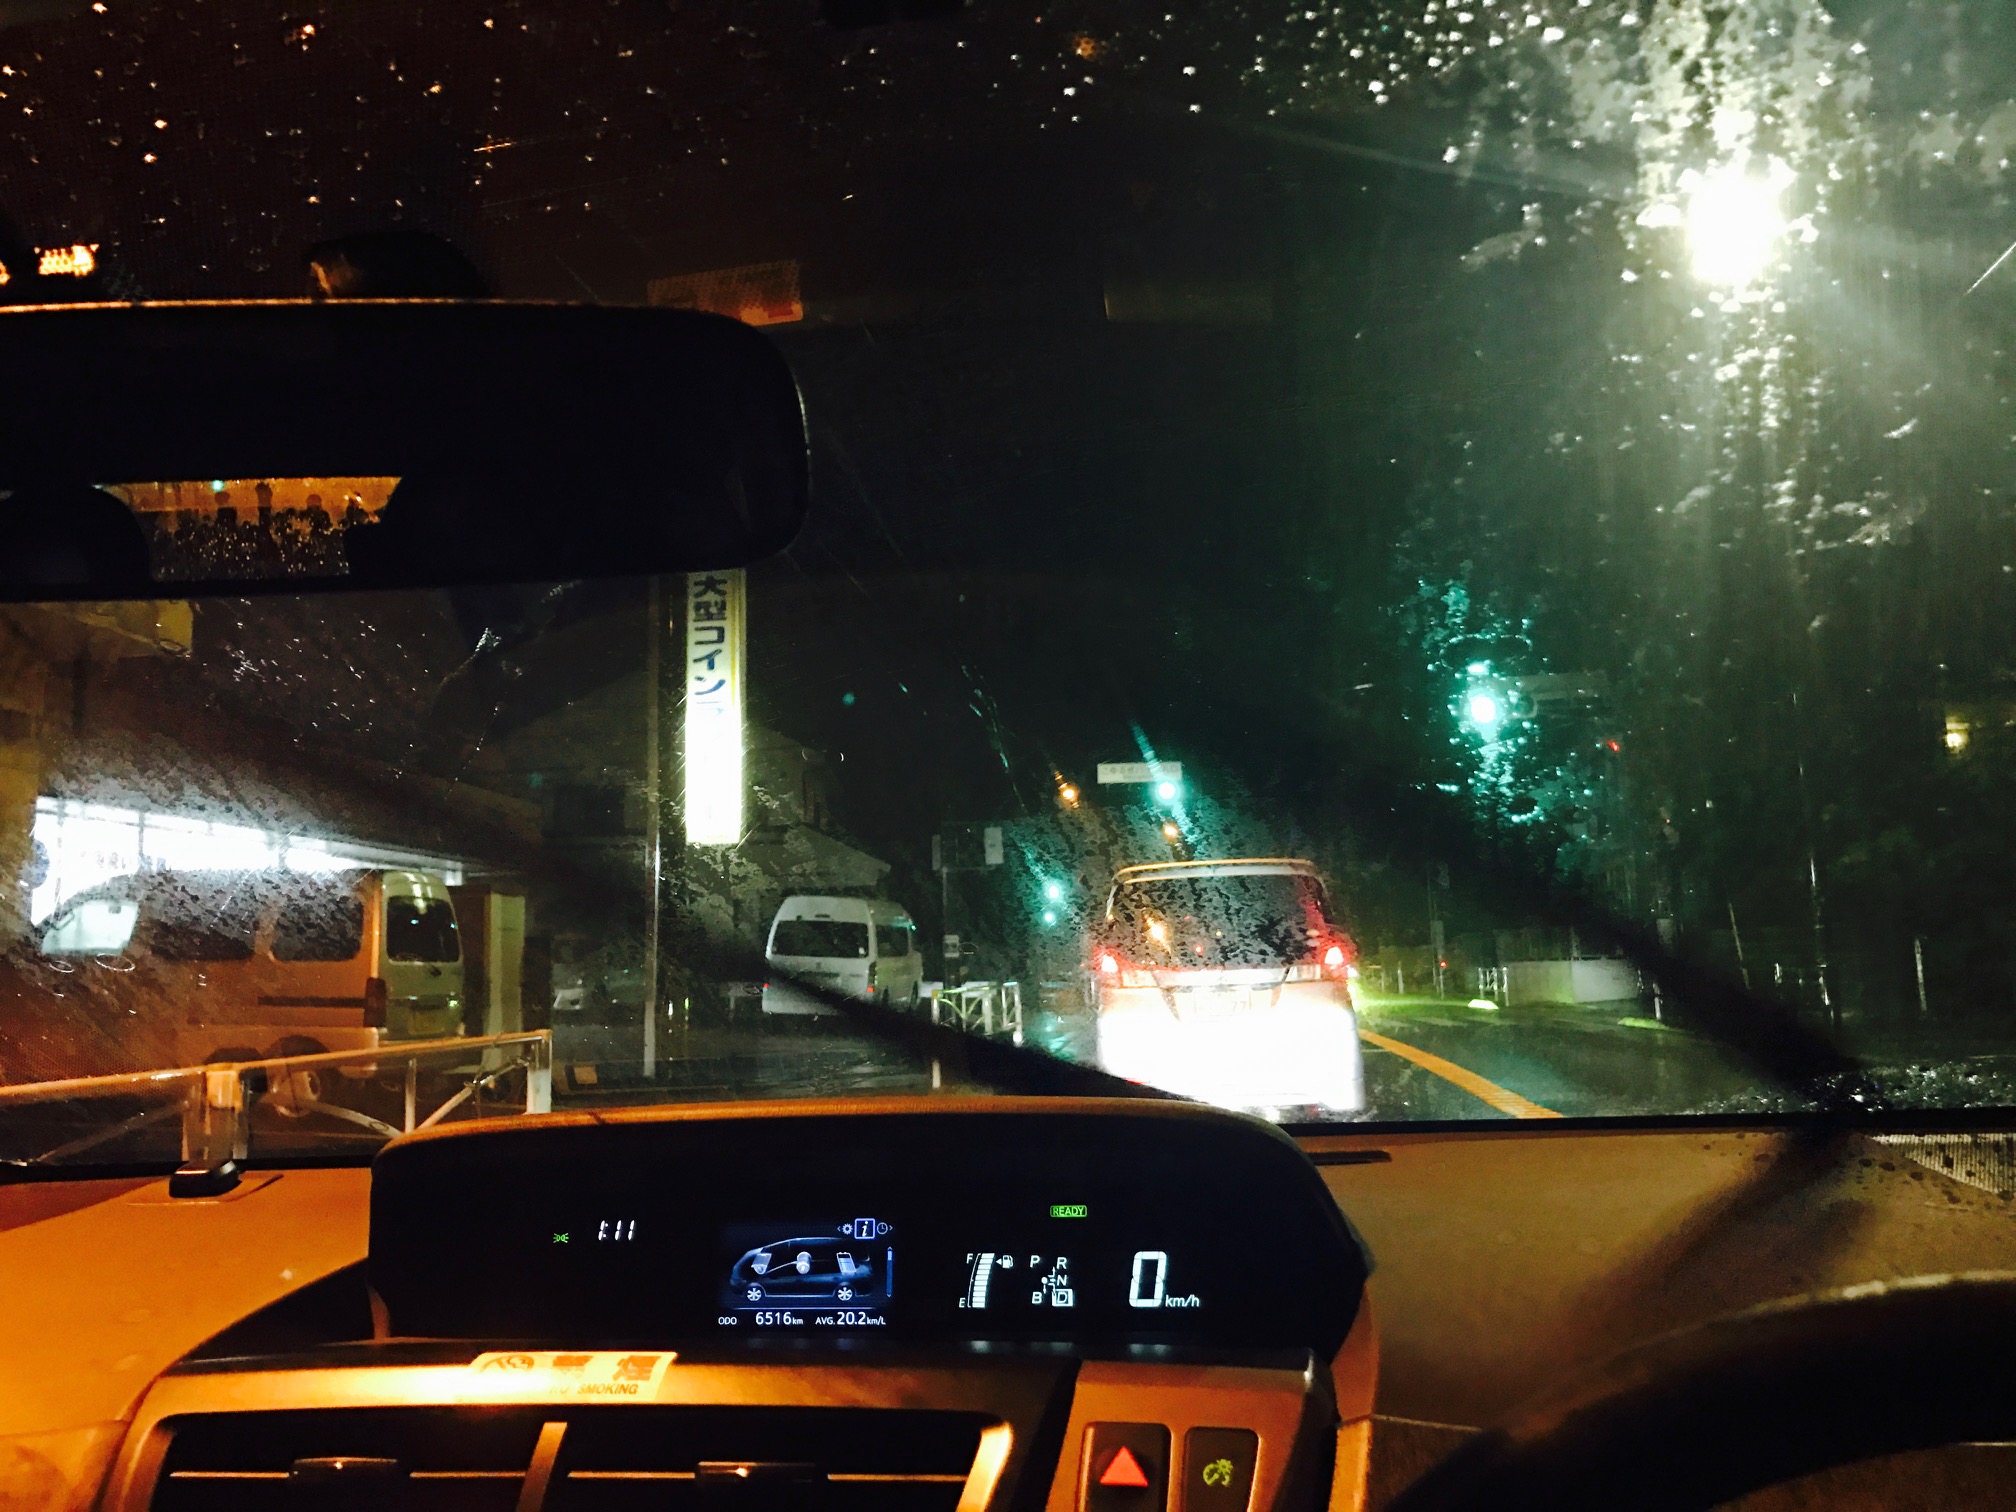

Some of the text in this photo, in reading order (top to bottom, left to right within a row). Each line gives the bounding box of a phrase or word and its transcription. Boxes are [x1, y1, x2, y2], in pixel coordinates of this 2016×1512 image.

[1052, 1206, 1084, 1217] READY
[598, 1219, 635, 1241] 1:11
[966, 1253, 973, 1264] F
[1030, 1255, 1067, 1269] P R
[1057, 1275, 1067, 1286] N
[1129, 1250, 1200, 1308] 0 km/h
[959, 1297, 966, 1308] E
[1031, 1292, 1068, 1304] B D
[718, 1316, 737, 1326] ODO
[577, 1383, 639, 1395] SMOKING
